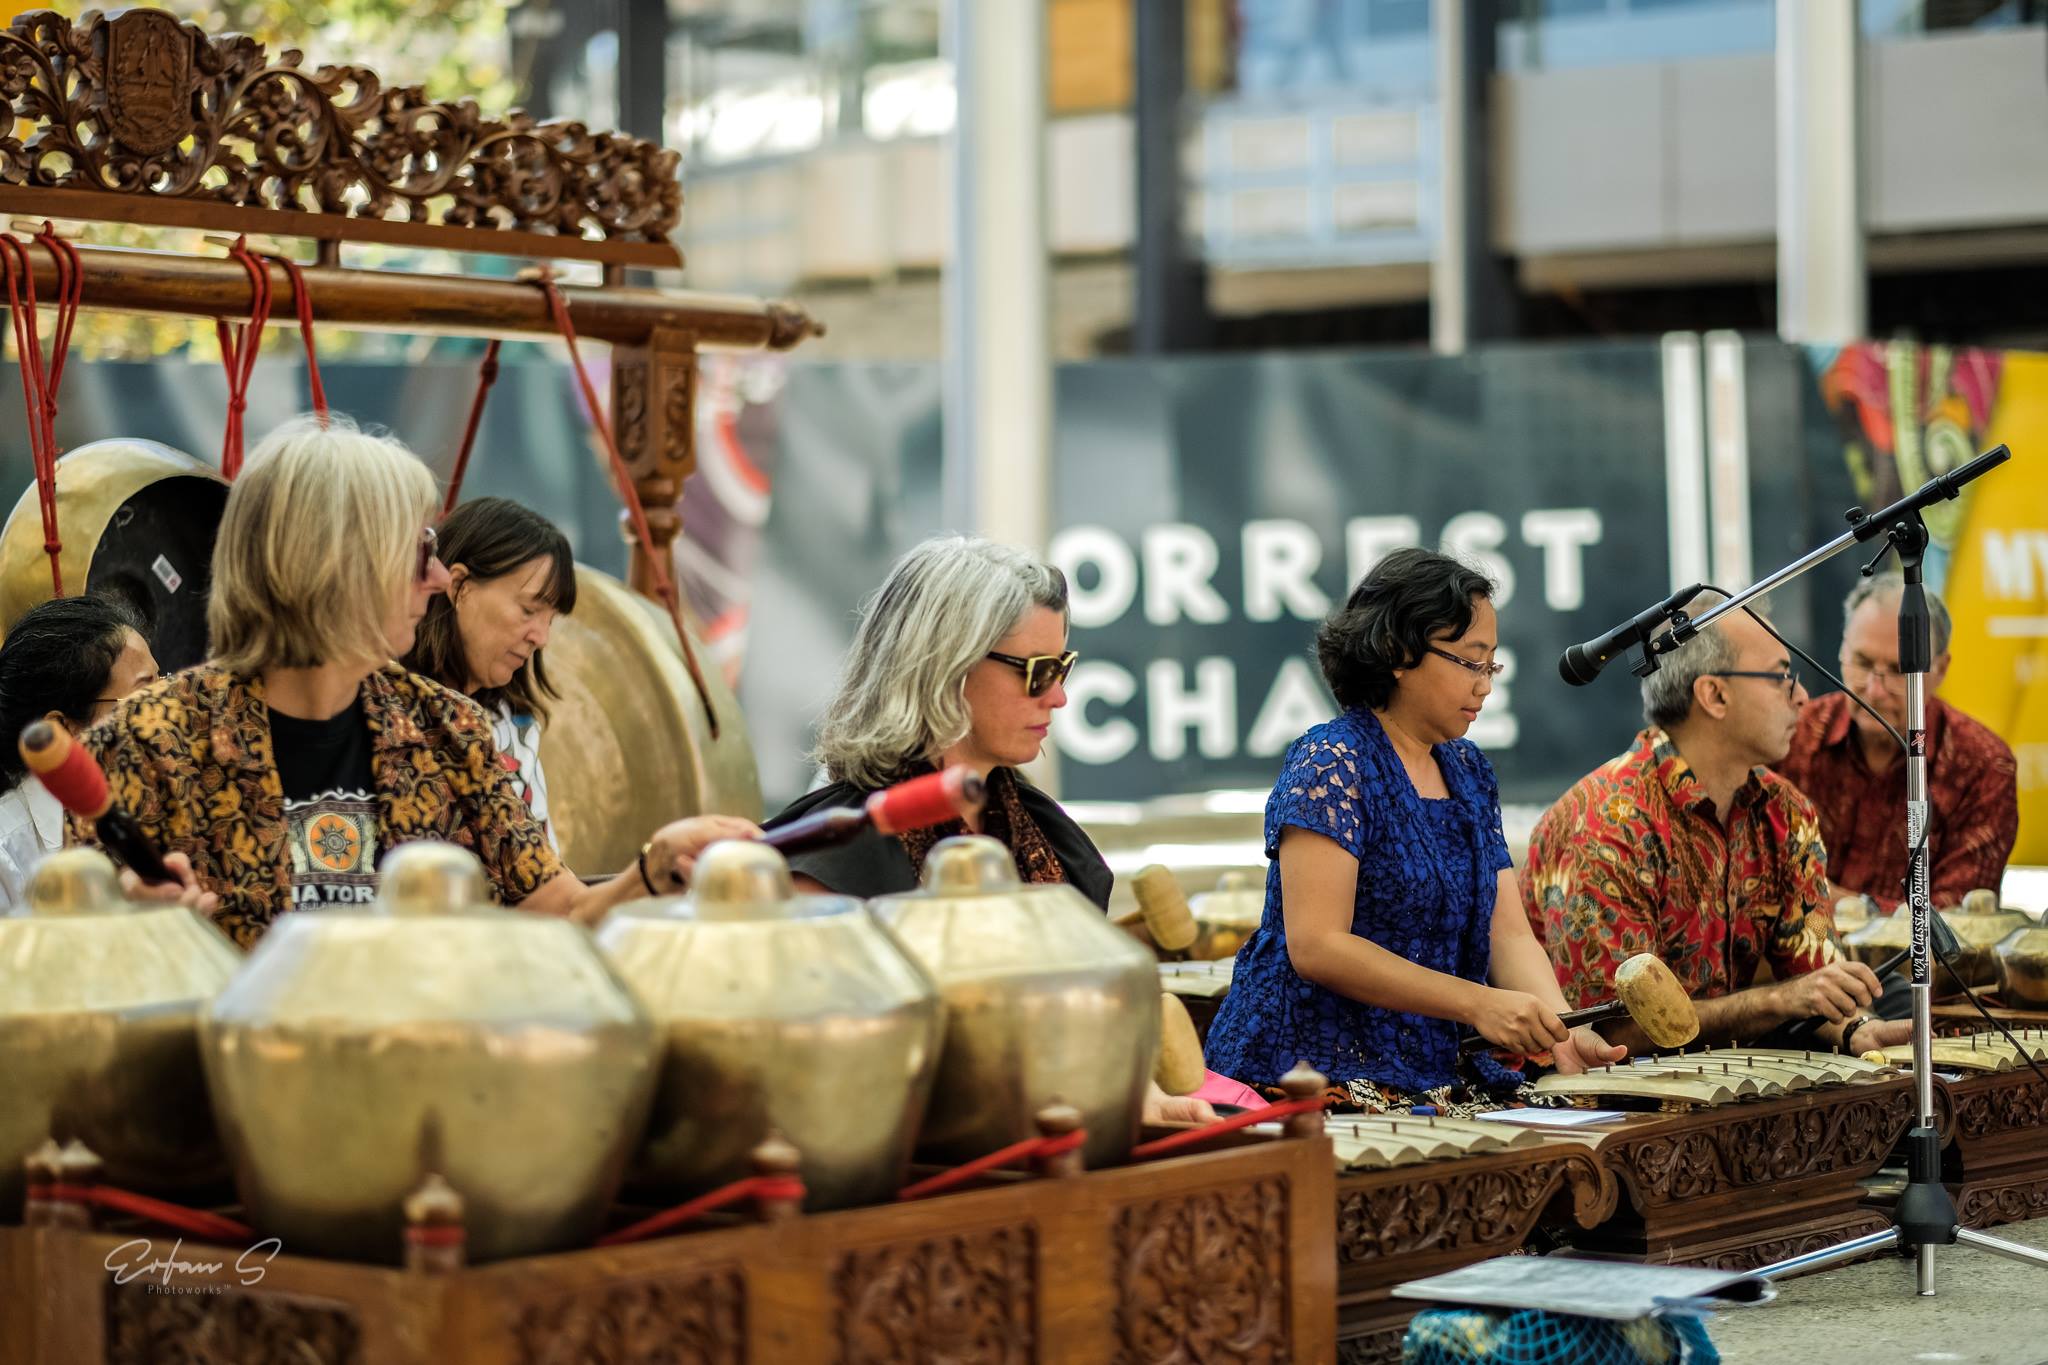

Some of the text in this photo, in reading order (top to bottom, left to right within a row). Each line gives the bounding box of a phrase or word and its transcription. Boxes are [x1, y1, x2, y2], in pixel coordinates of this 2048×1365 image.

[1053, 646, 1520, 765] CHAE
[1911, 911, 1926, 956] Classic
[1914, 958, 1926, 979] WA
